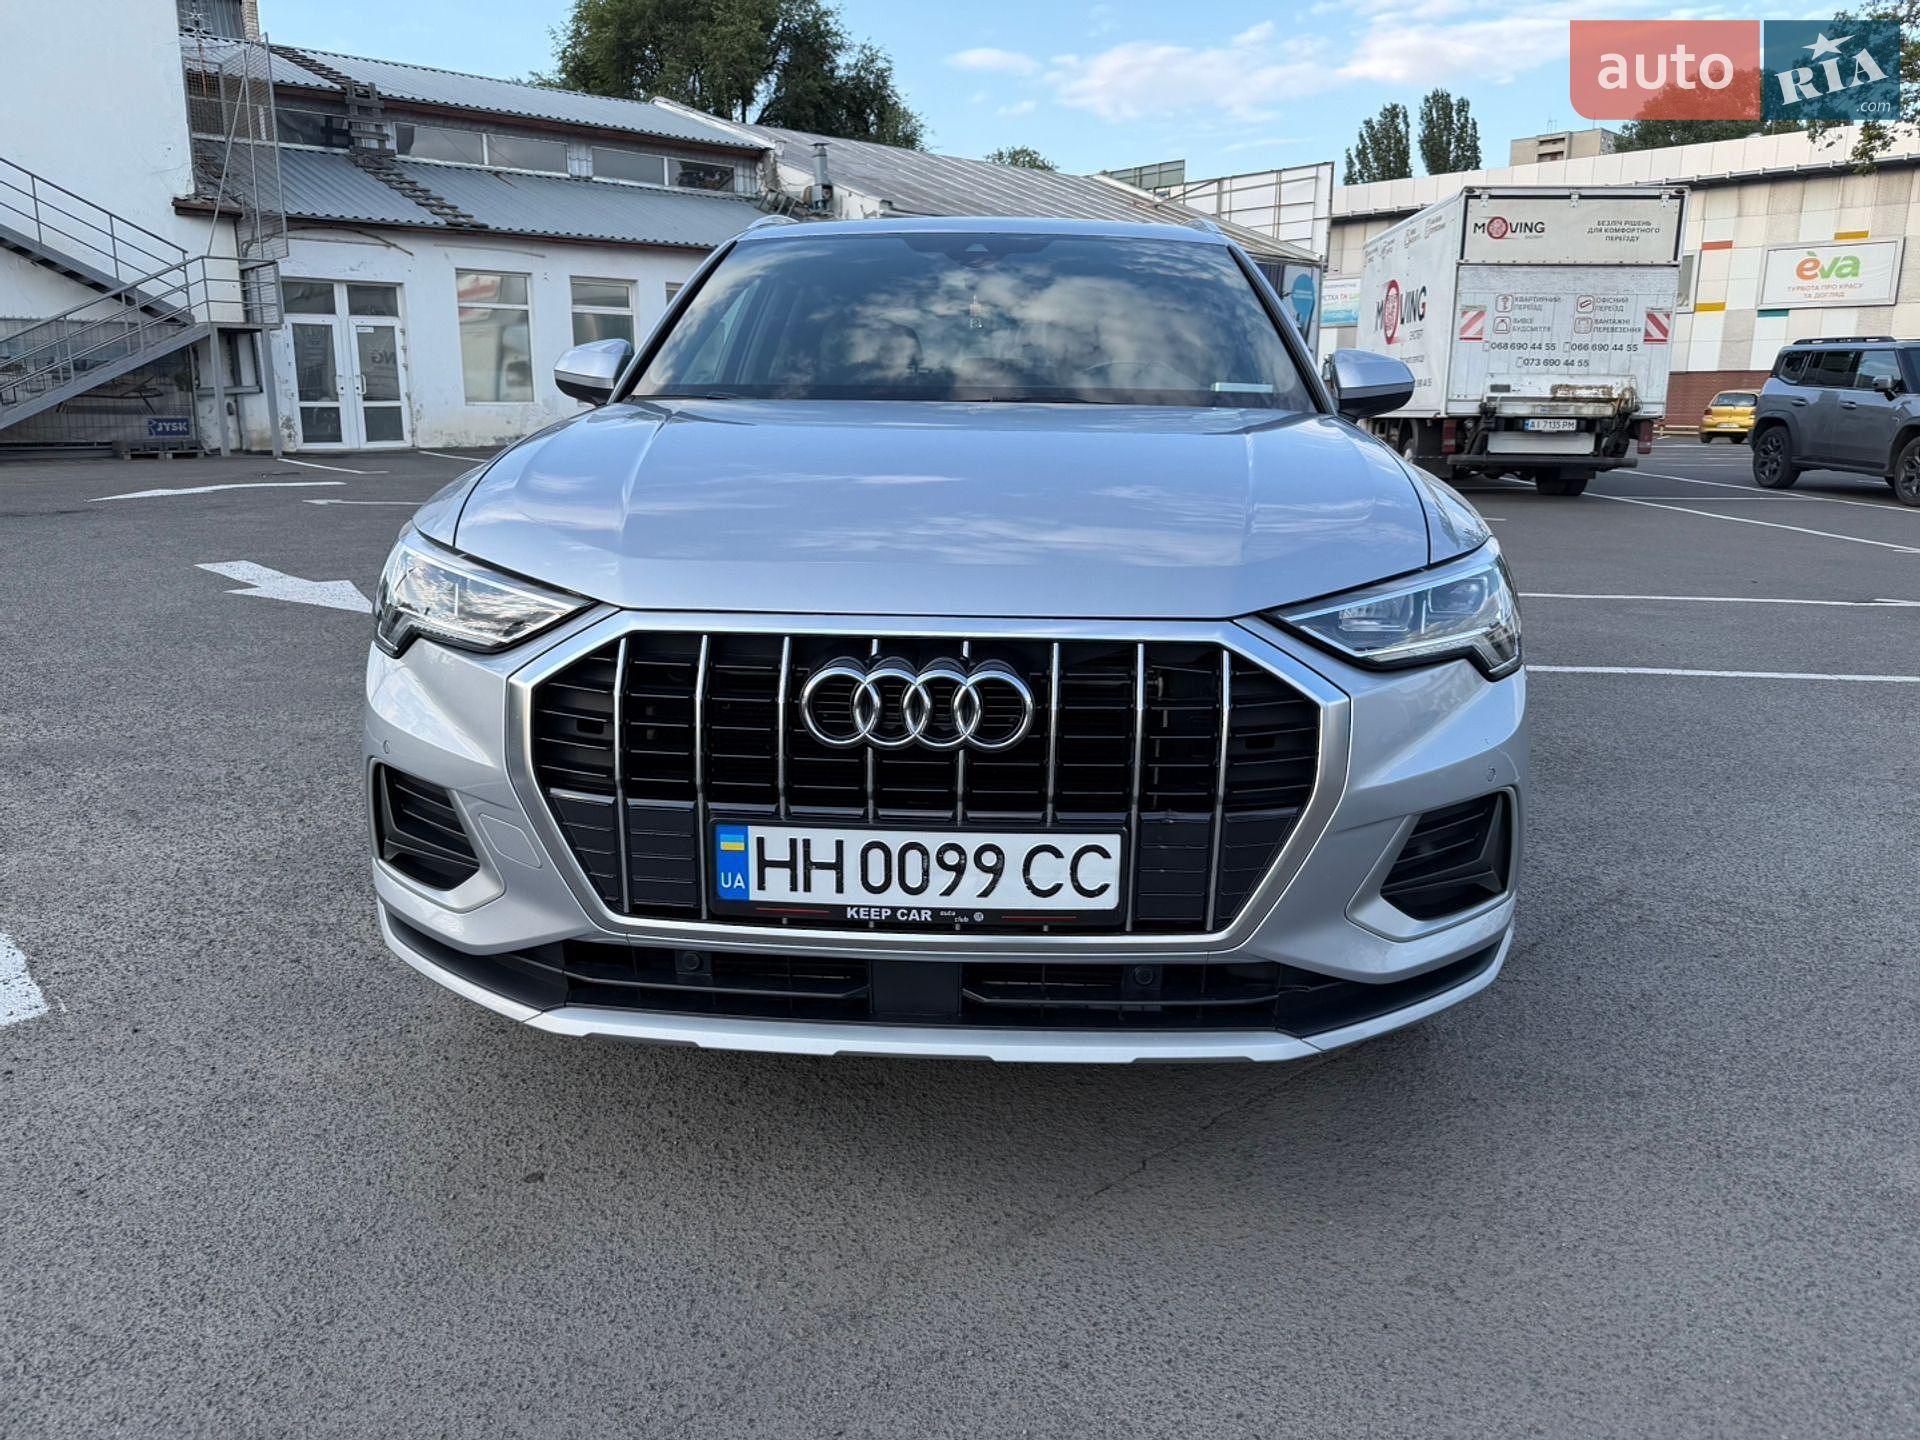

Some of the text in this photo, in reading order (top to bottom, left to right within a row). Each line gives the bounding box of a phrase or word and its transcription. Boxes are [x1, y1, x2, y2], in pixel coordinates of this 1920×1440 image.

[1473, 216, 1545, 240] MOVING
[1605, 234, 1639, 242] ПЕРЕЇЗДУ
[1490, 342, 1508, 350] 068
[1571, 343, 1589, 351] 066
[1523, 358, 1540, 366] 073
[1577, 359, 1589, 367] 55
[156, 422, 188, 431] JYSK
[756, 836, 1112, 898] HH 0099 CC
[721, 872, 746, 889] UA
[846, 907, 932, 921] KEEP CAR
